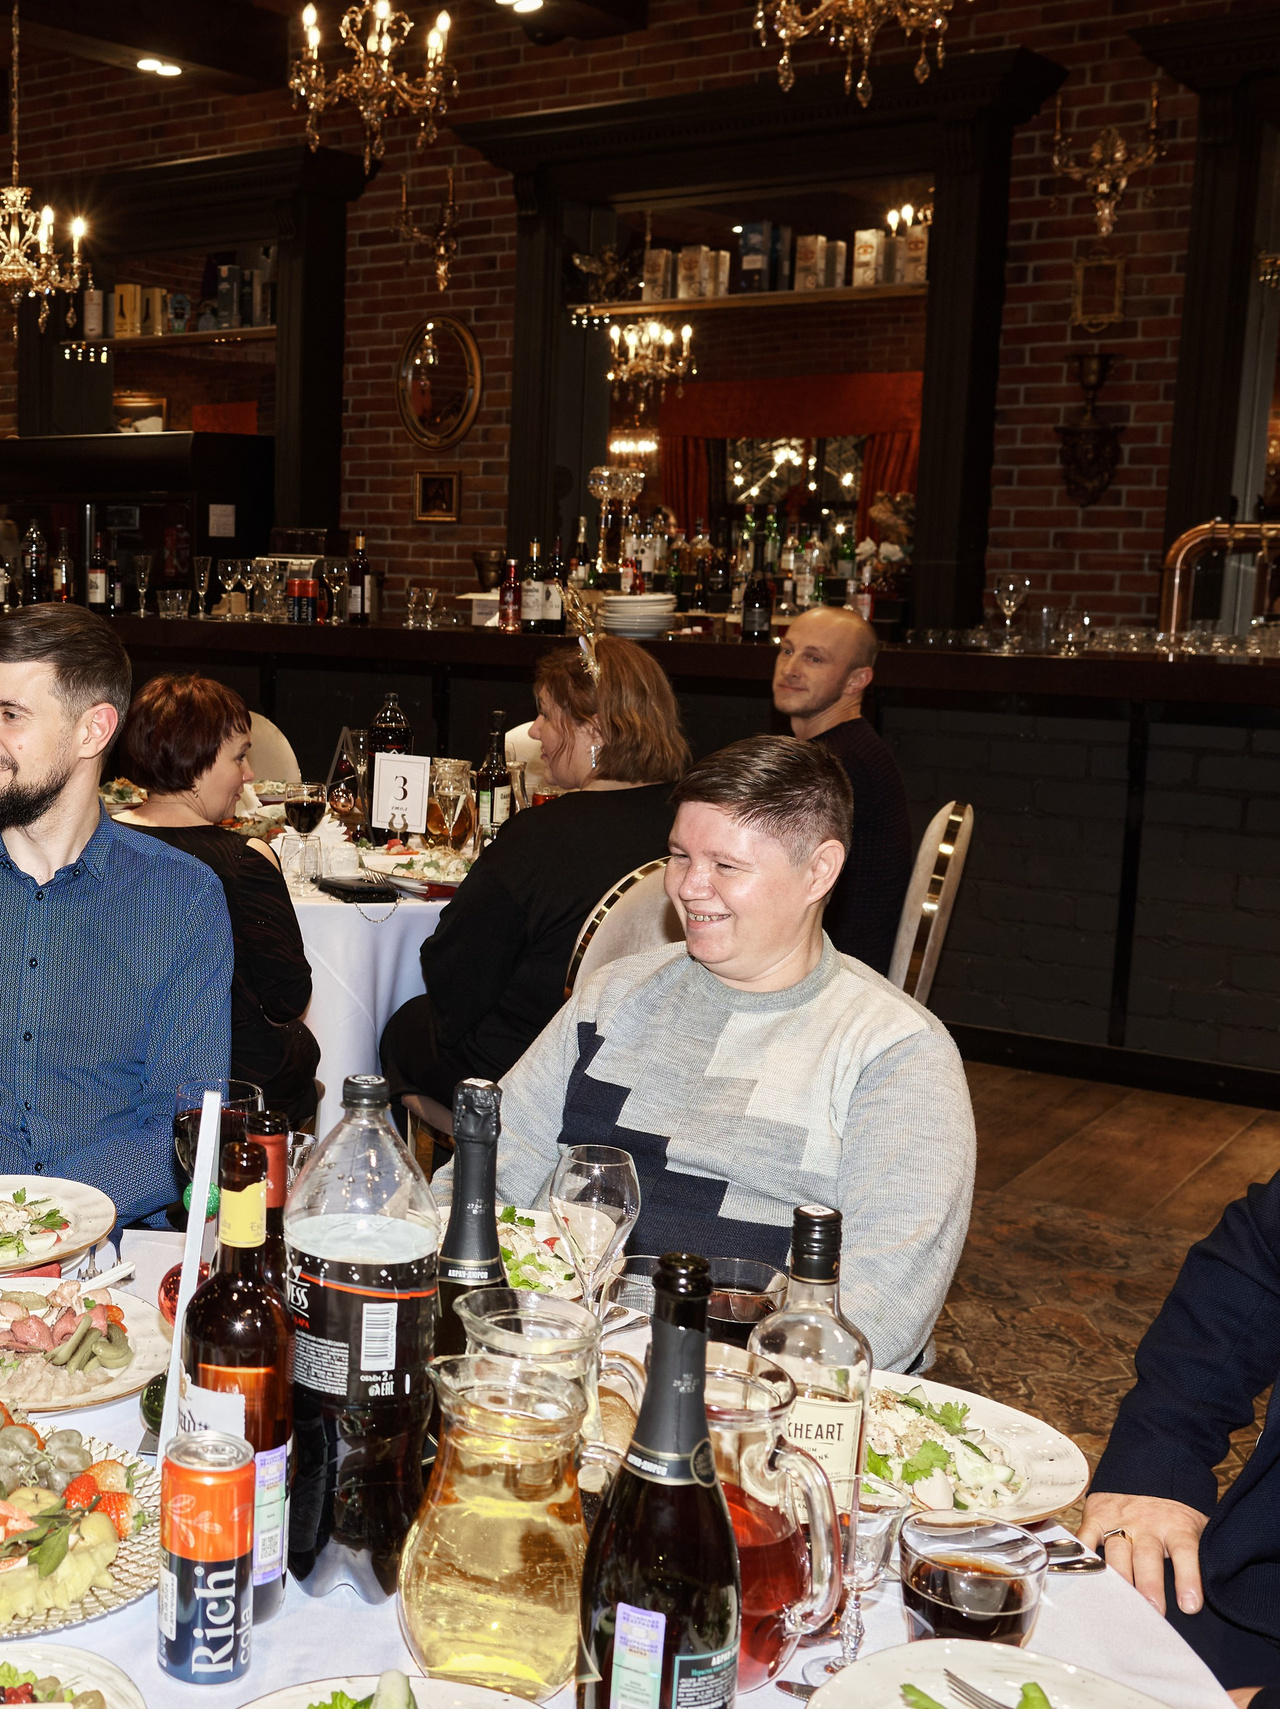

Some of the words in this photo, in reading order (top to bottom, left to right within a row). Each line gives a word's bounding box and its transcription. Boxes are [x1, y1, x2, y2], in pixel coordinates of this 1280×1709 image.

[393, 775, 408, 801] 3
[382, 1370, 388, 1381] 2
[191, 1566, 236, 1674] Rich
[237, 1605, 251, 1666] cola
